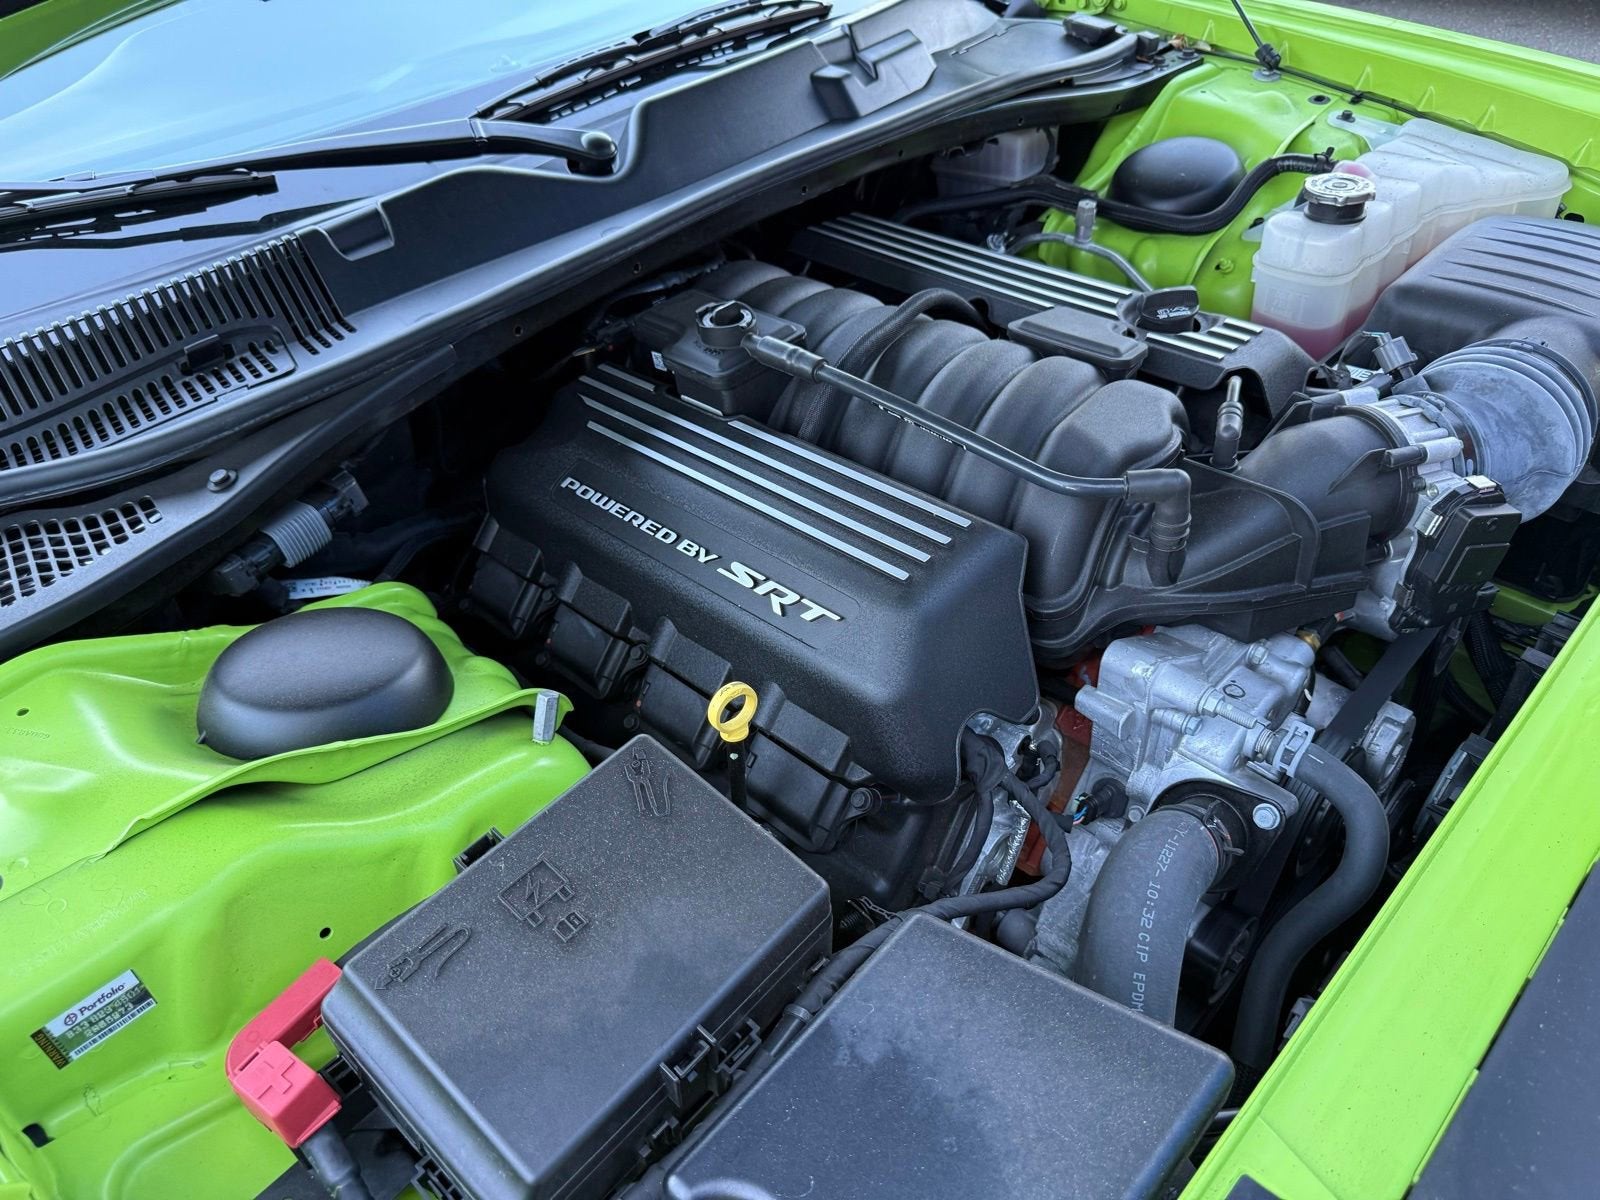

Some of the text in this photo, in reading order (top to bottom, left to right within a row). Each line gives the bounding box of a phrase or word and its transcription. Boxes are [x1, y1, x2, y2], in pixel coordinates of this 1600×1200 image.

[560, 476, 843, 621] POWERED BY SRT
[78, 983, 125, 1017] Portfolio
[1131, 972, 1147, 1012] EPDM
[34, 1033, 65, 1067] WARNING
